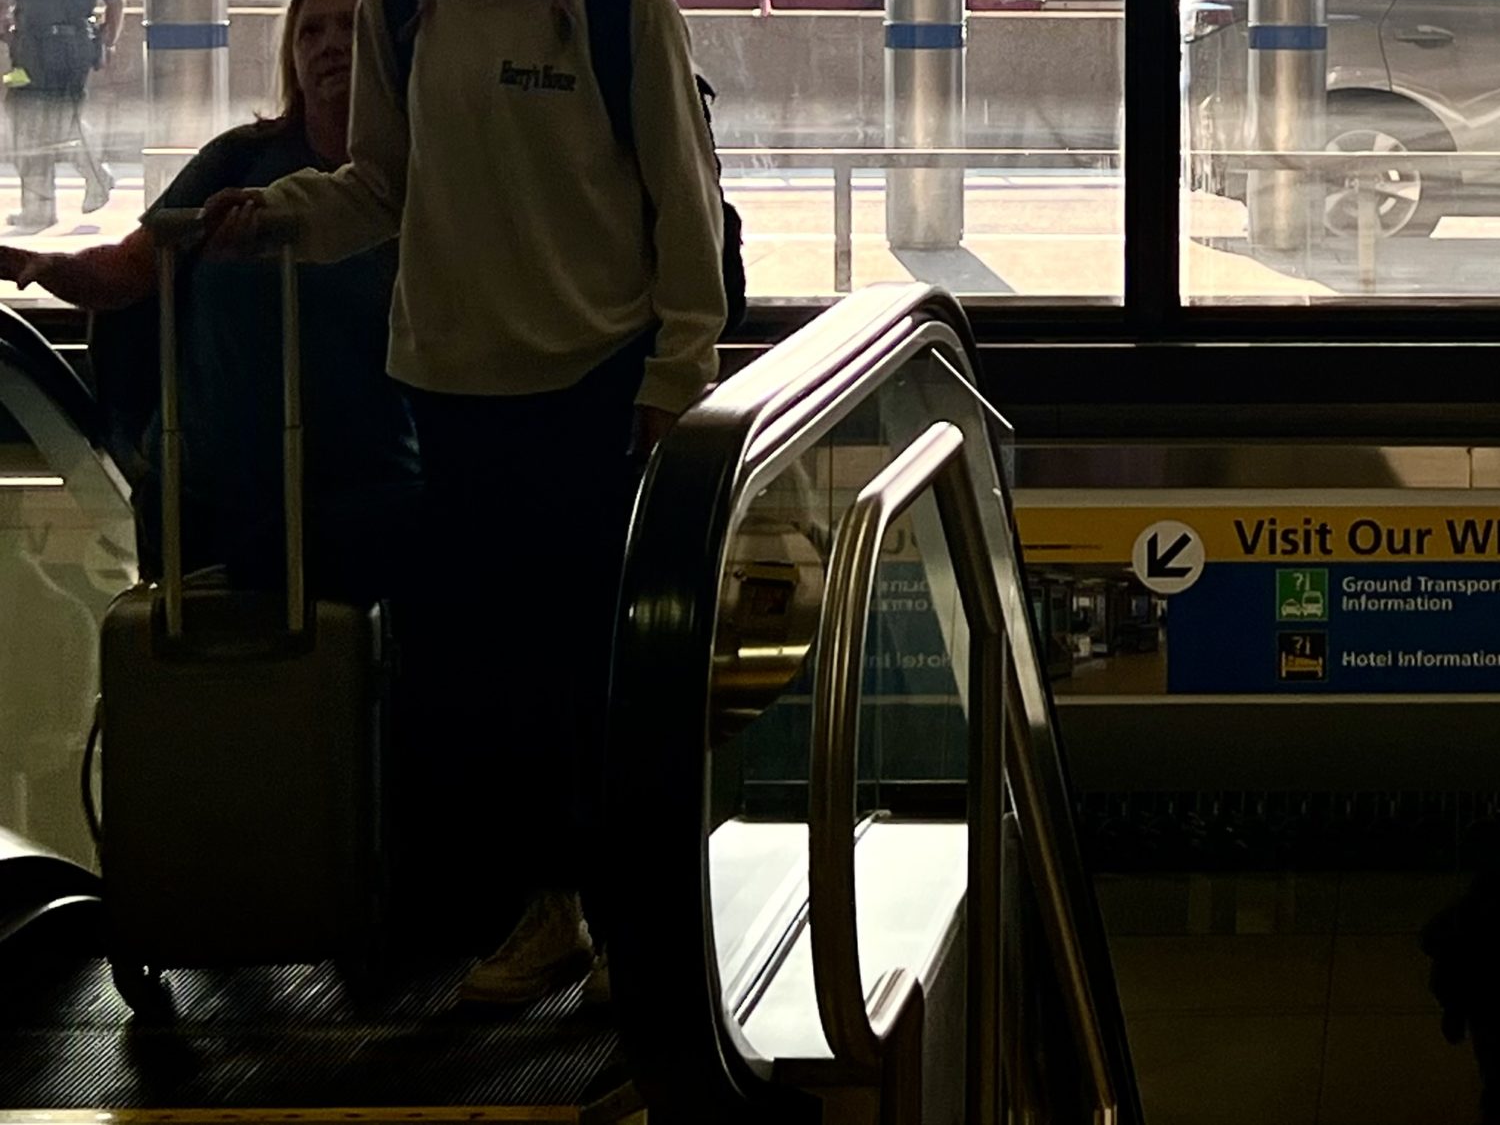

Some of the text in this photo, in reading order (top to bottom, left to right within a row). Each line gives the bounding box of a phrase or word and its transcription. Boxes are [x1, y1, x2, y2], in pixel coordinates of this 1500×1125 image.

[1234, 517, 1333, 555] Visit
[1348, 518, 1433, 556] Our
[1341, 576, 1412, 593] Ground
[1341, 594, 1453, 611] Information
[1341, 650, 1393, 668] Hotel
